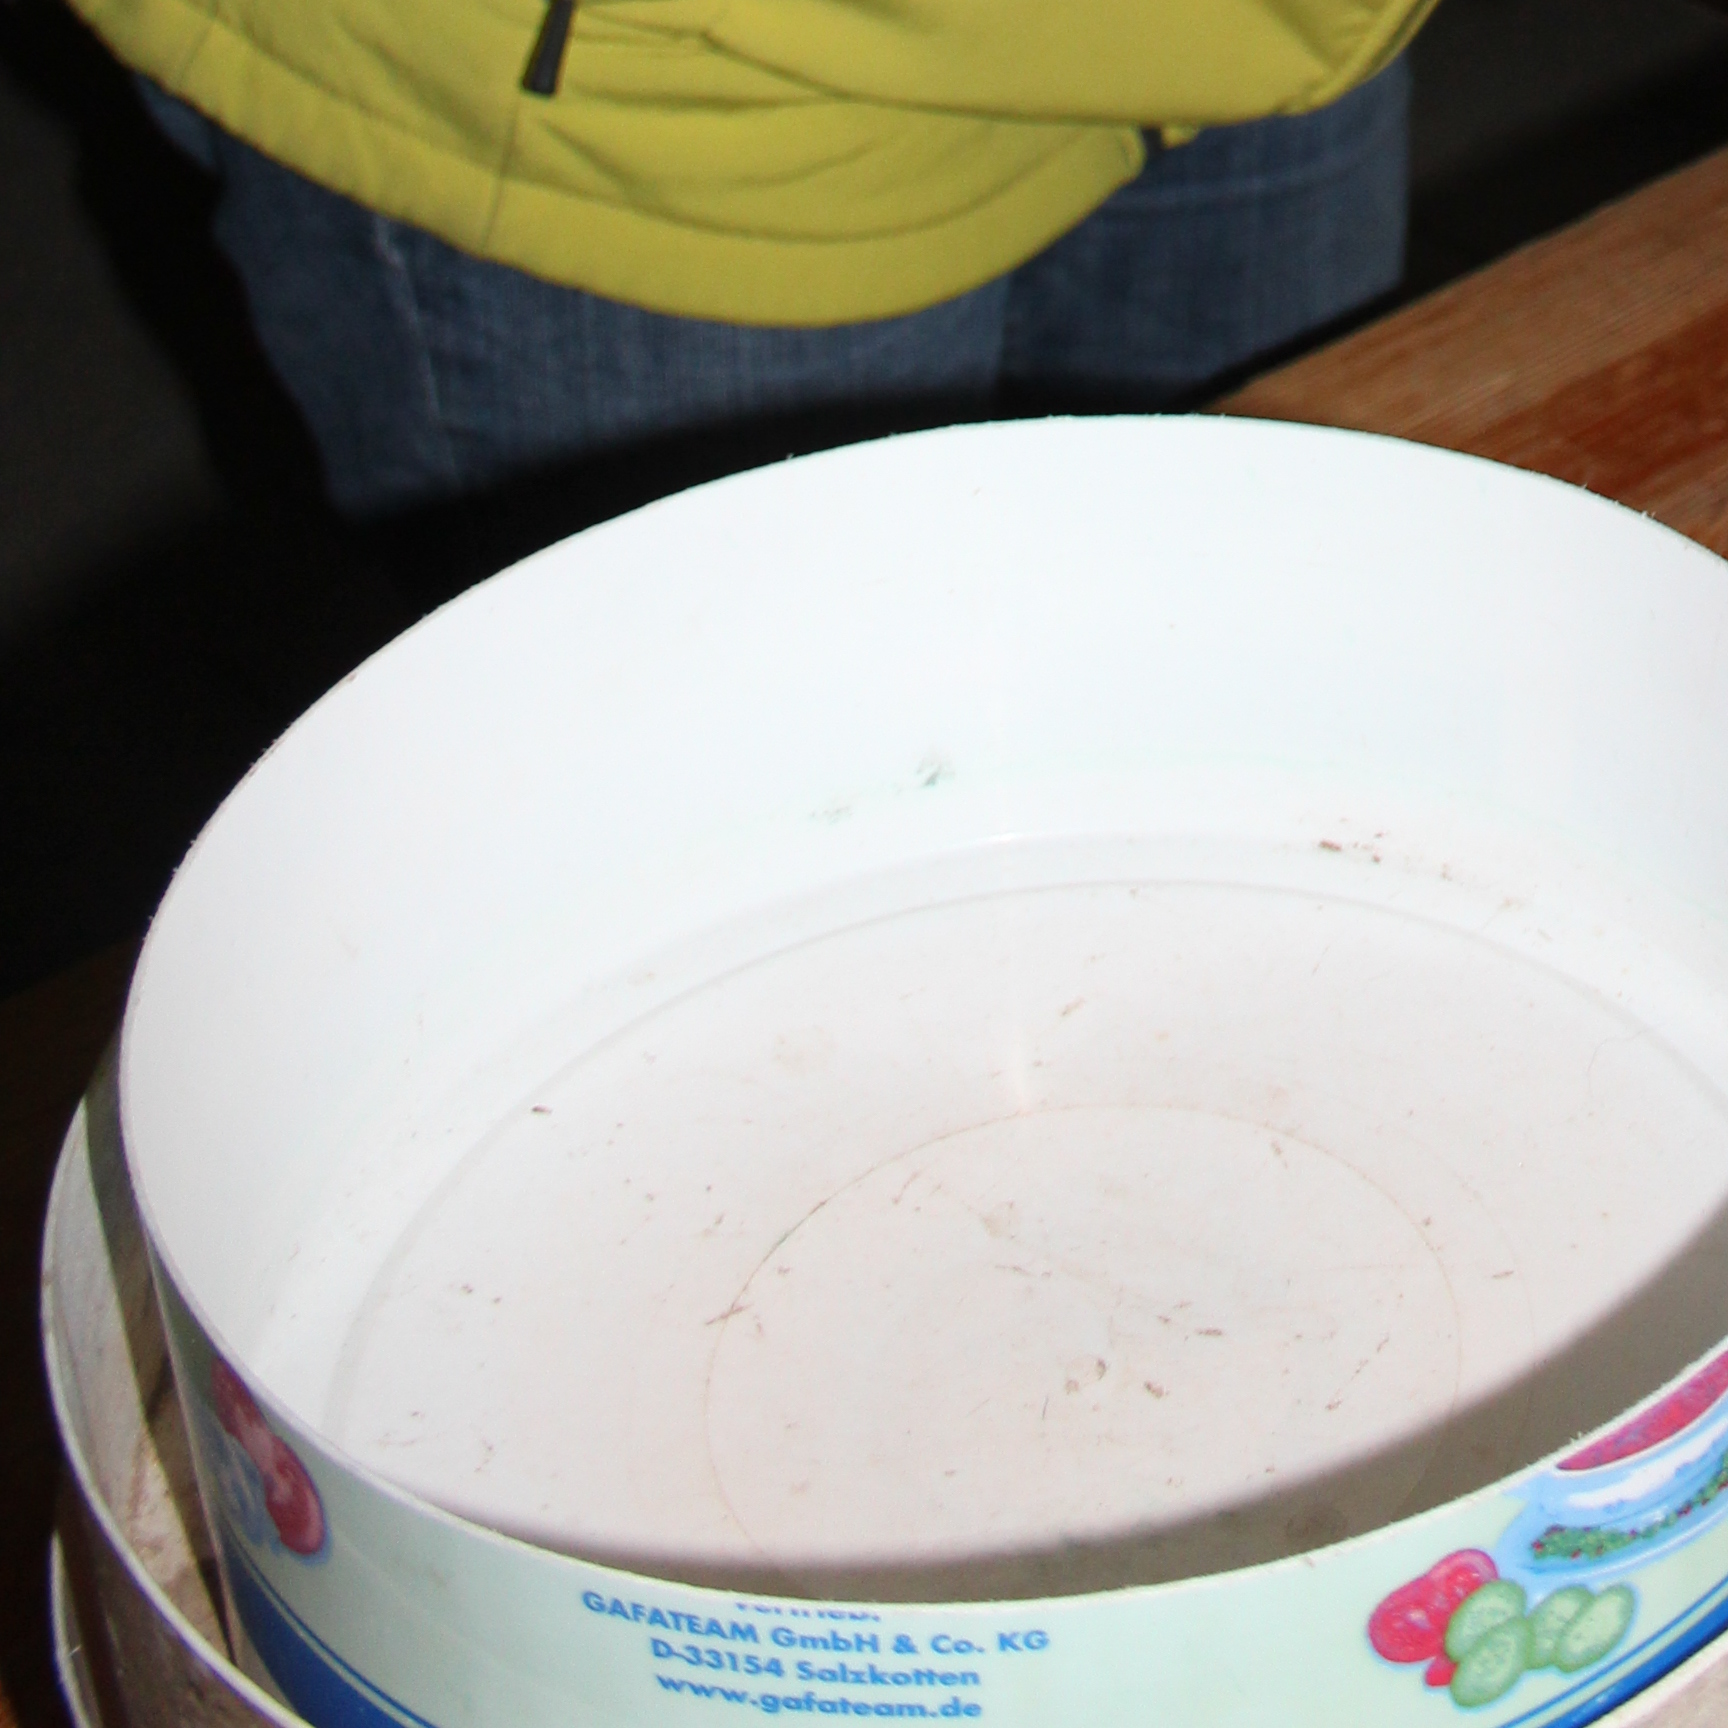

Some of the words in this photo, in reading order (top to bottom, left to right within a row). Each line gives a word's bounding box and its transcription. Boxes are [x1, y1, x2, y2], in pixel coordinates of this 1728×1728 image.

[577, 1590, 759, 1644] GAFATEAM
[771, 1626, 880, 1653] GmbH
[892, 1633, 918, 1654] &
[930, 1634, 985, 1654] Co.
[998, 1629, 1049, 1652] KG
[650, 1637, 785, 1678] D-33154
[796, 1660, 980, 1687] Salzkotten
[656, 1675, 982, 1718] www.gafateam.de
